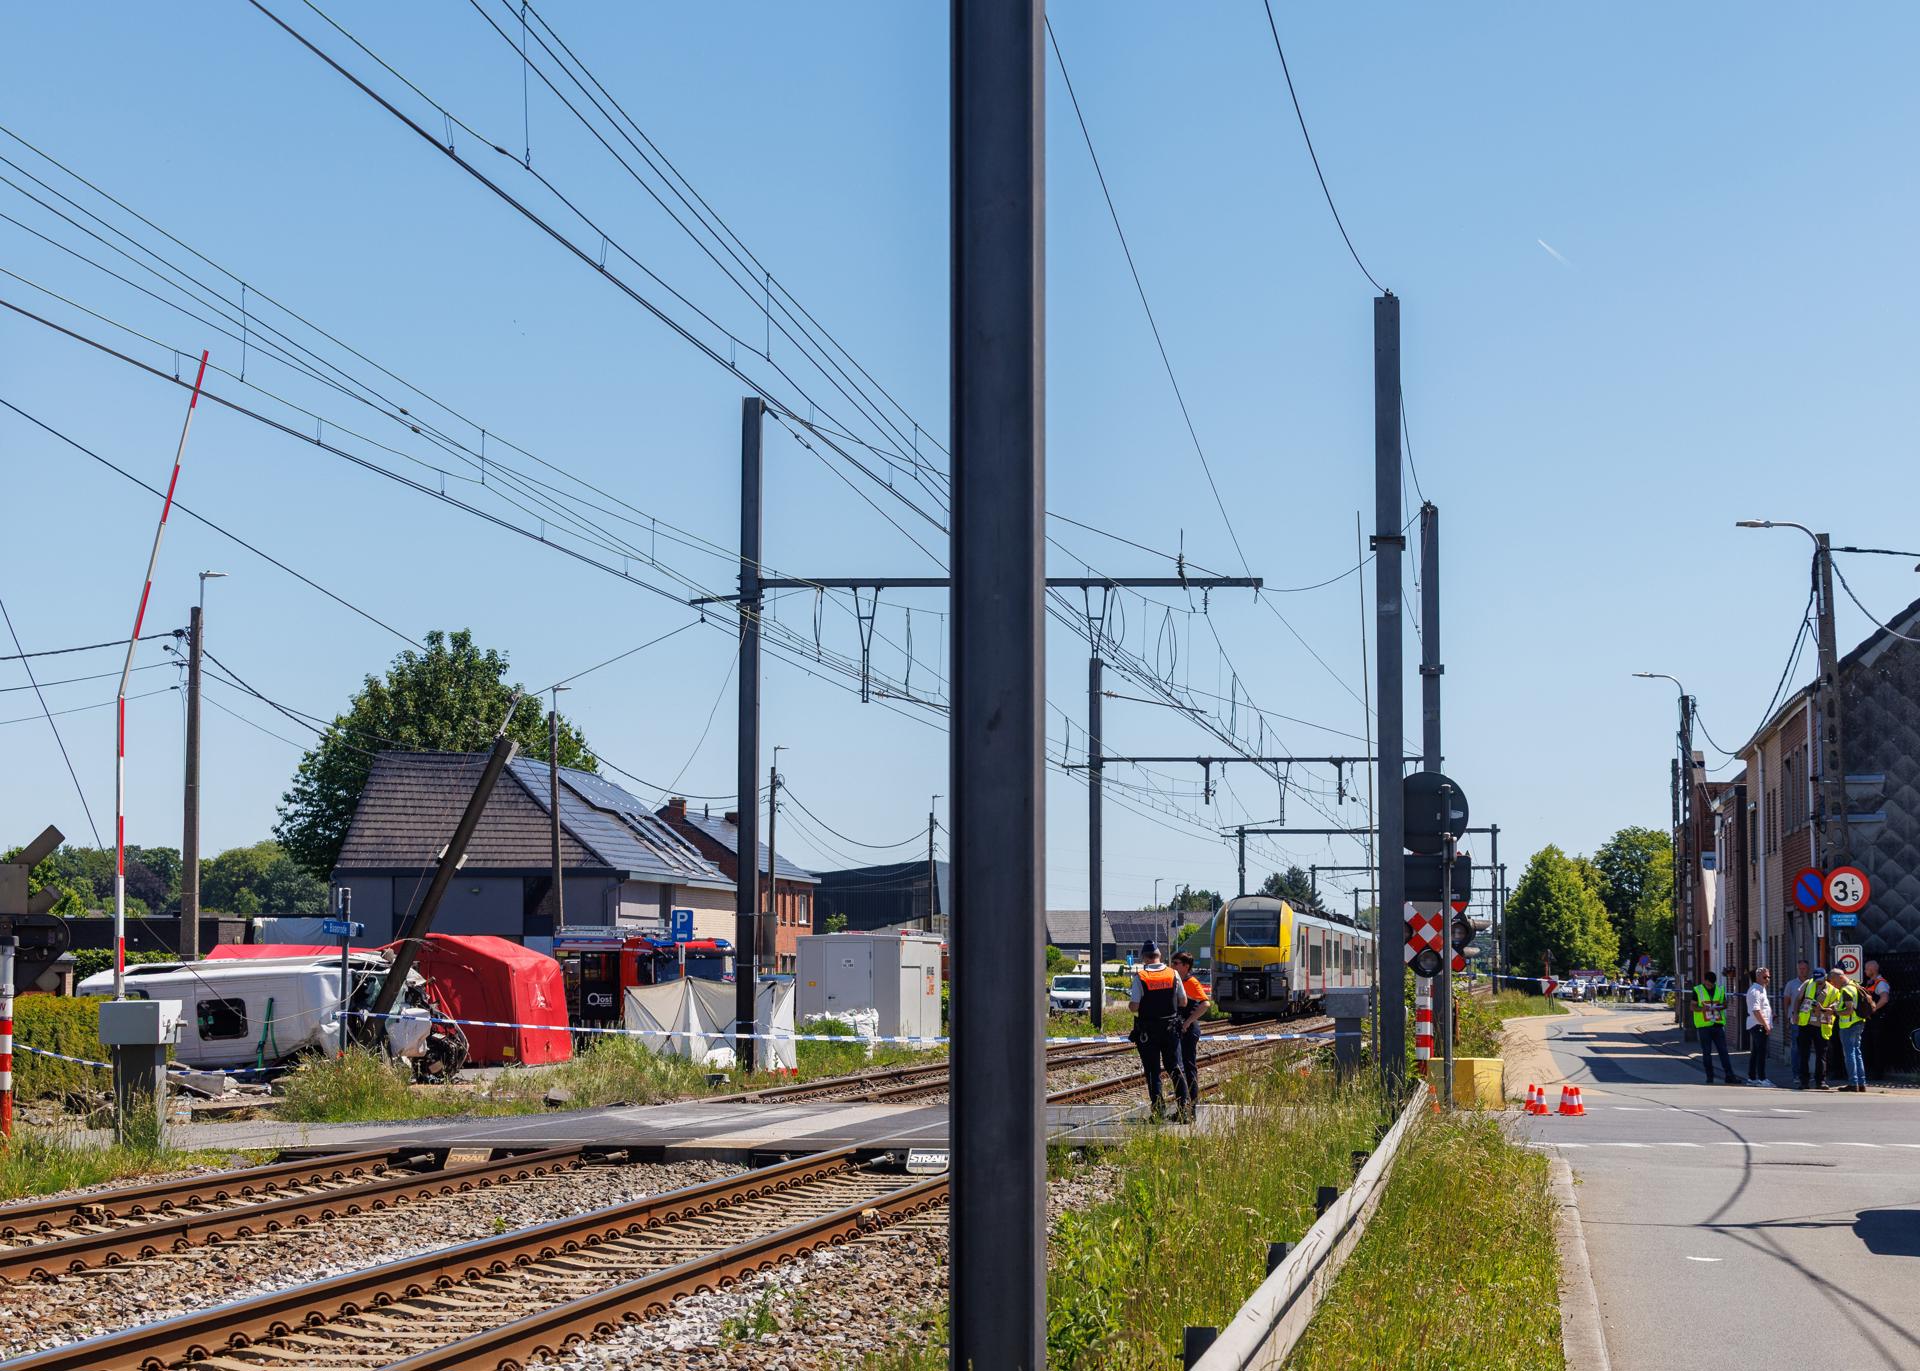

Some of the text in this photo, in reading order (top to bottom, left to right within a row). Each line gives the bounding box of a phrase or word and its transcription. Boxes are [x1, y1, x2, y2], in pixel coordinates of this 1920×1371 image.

[1833, 880, 1860, 902] 3 5
[676, 911, 689, 929] P
[1843, 960, 1856, 969] 30
[910, 1153, 949, 1163] STRAIL
